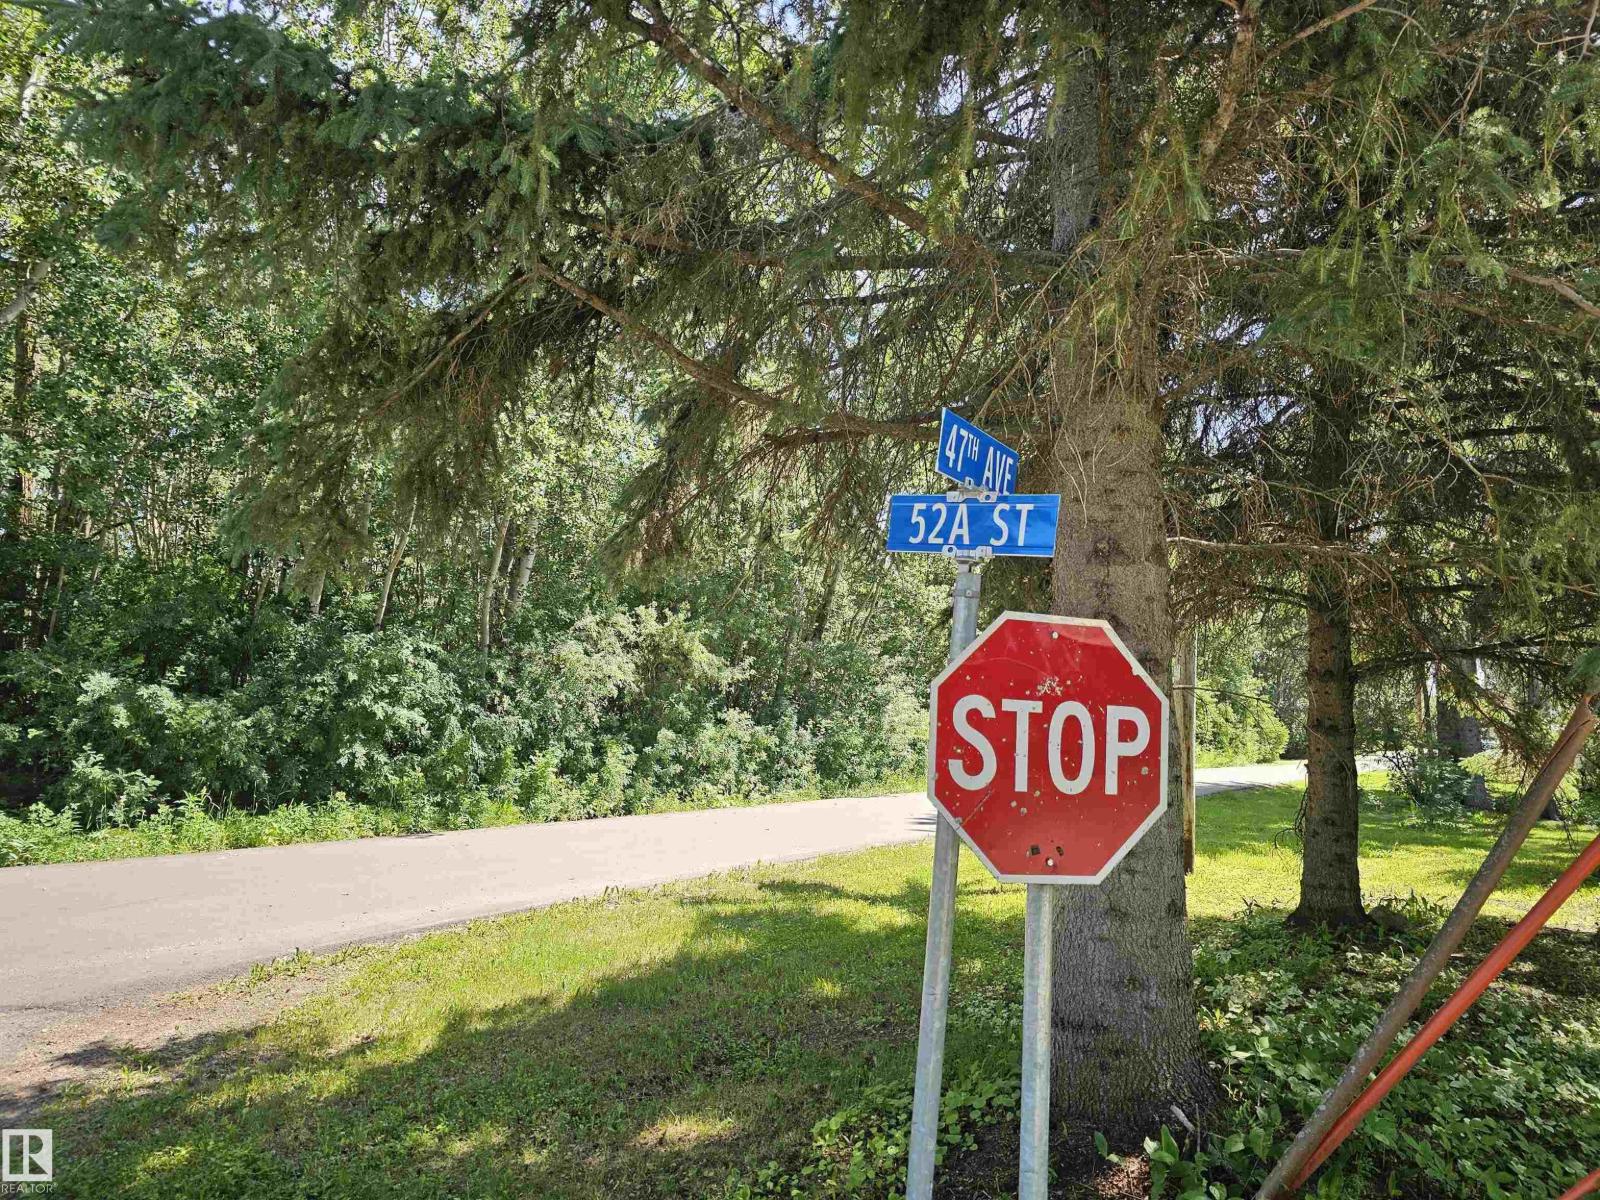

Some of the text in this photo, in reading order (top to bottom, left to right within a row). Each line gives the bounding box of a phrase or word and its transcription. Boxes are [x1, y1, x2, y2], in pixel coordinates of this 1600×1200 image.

[945, 424, 1014, 496] 47TH AVE
[908, 502, 1035, 546] 52A ST
[947, 694, 1151, 796] STOP
